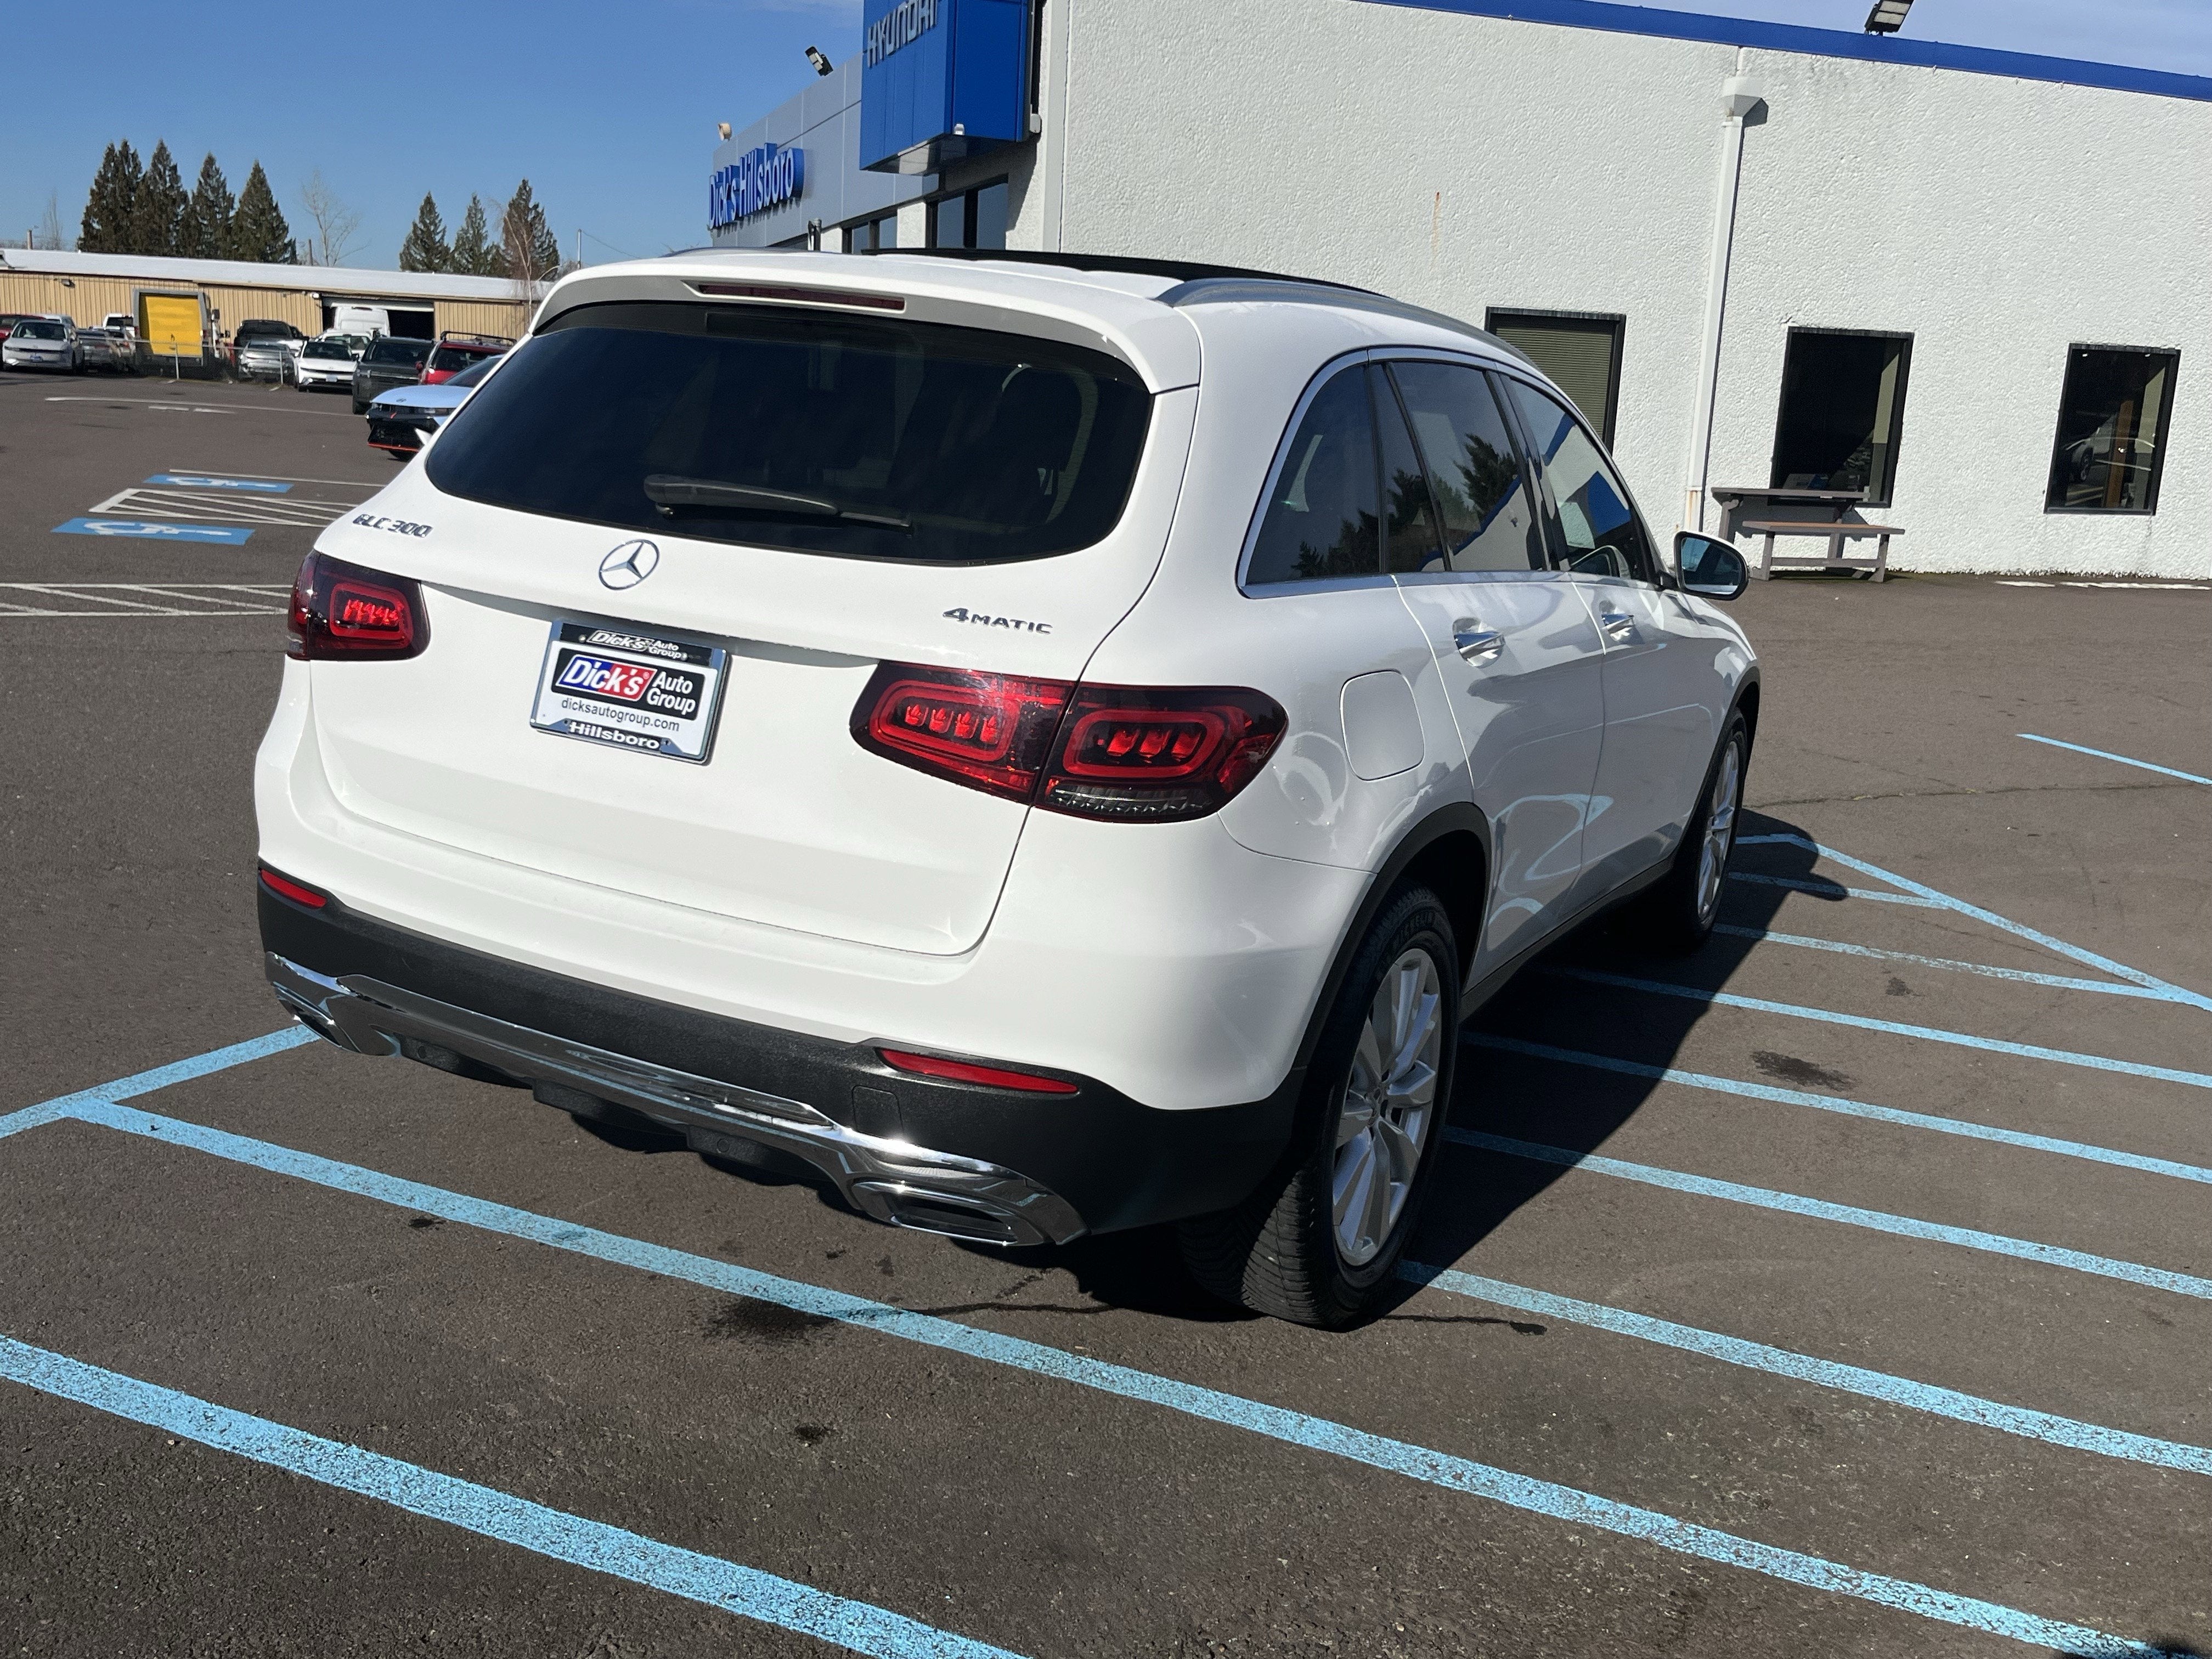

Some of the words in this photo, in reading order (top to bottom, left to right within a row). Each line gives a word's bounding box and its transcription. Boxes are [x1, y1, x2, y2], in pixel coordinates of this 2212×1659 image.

[867, 0, 938, 68] HYUNDAI
[709, 165, 737, 229] Dick's
[739, 143, 794, 217] Hillsboro
[352, 514, 392, 529] GLC
[387, 520, 434, 538] 300
[943, 607, 1053, 635] 4MATIC
[591, 632, 646, 650] Dick's
[648, 647, 681, 659] Group
[654, 640, 679, 651] Auto
[563, 659, 645, 696] Dick's
[652, 672, 693, 694] Auto
[561, 698, 680, 732] dicksautogroup.com
[647, 689, 696, 715] Group
[568, 721, 659, 749] Hillsboro
